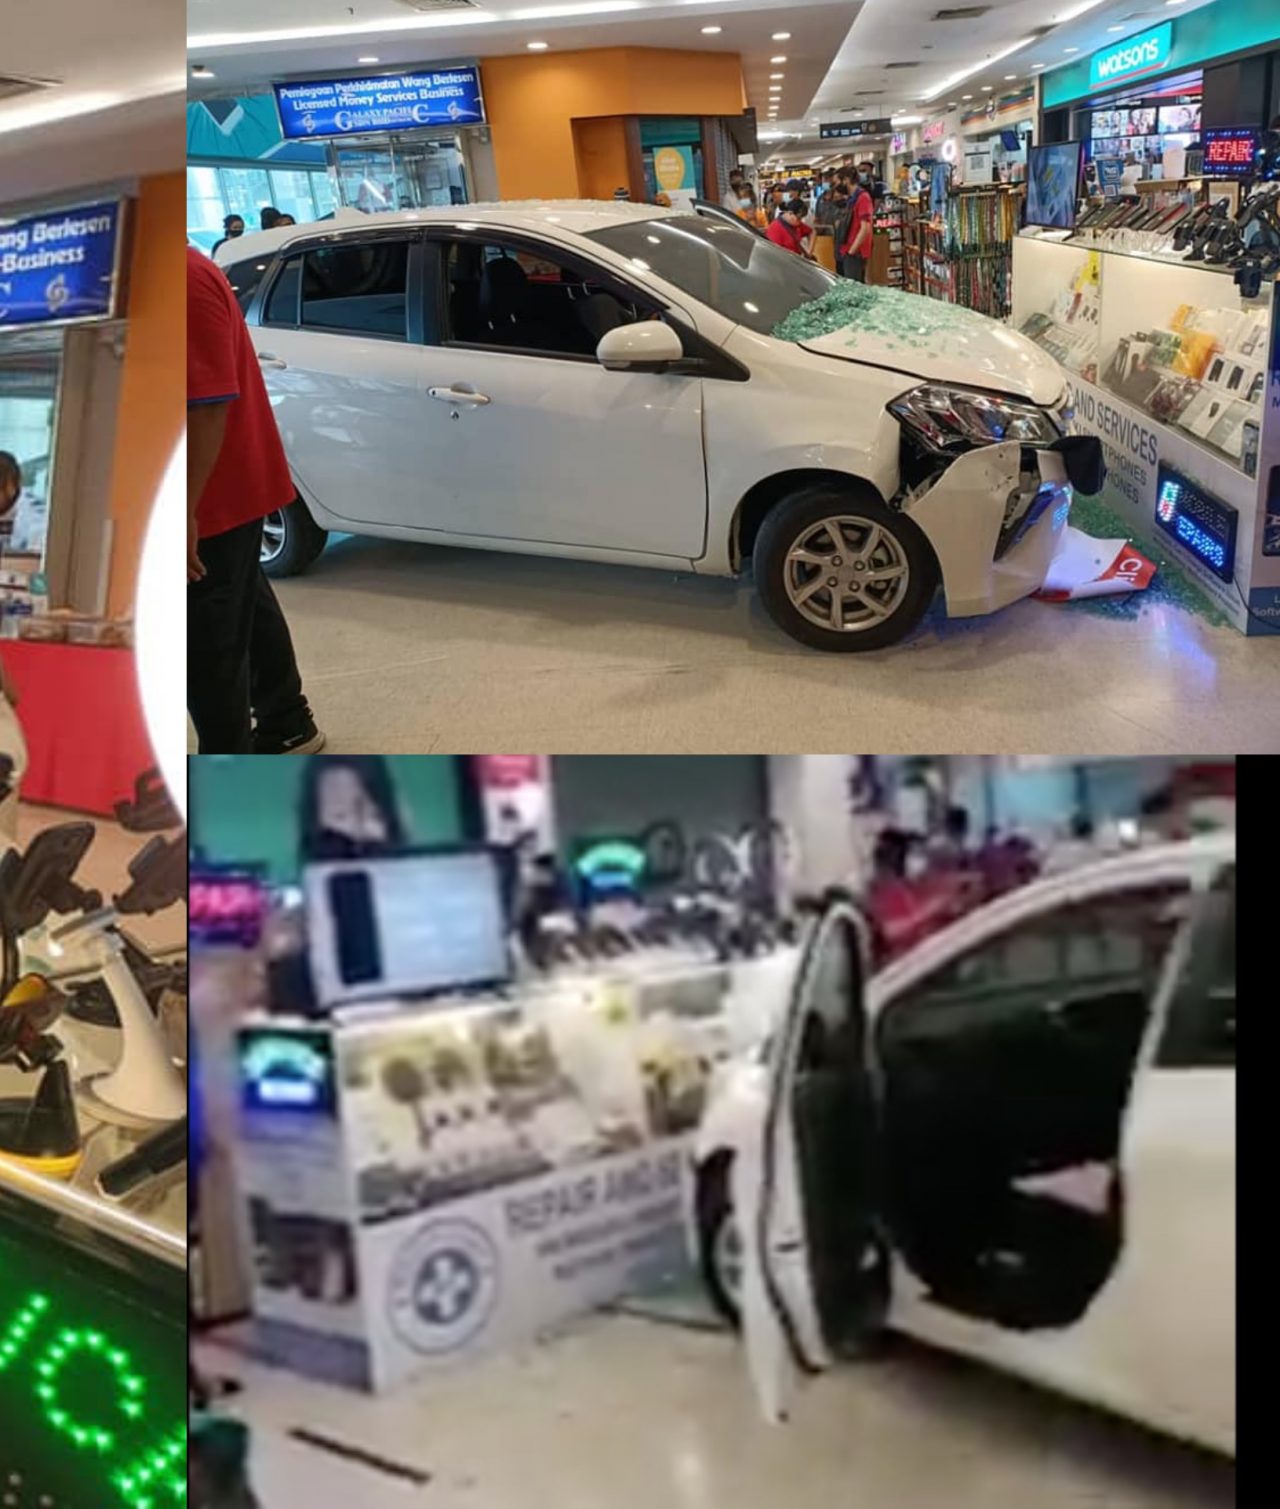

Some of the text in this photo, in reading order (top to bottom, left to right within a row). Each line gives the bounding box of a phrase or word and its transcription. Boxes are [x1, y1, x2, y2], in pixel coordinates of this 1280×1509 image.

[1098, 38, 1159, 78] watsons
[336, 77, 401, 94] Perkhidmatan
[402, 73, 431, 89] Wang
[432, 72, 474, 86] Berlesen
[292, 87, 465, 112] Licensed Money Services Business
[1209, 140, 1251, 162] REPAIR
[32, 216, 111, 243] Berlesen
[2, 246, 85, 274] Business
[1073, 388, 1158, 467] AND SERVICES
